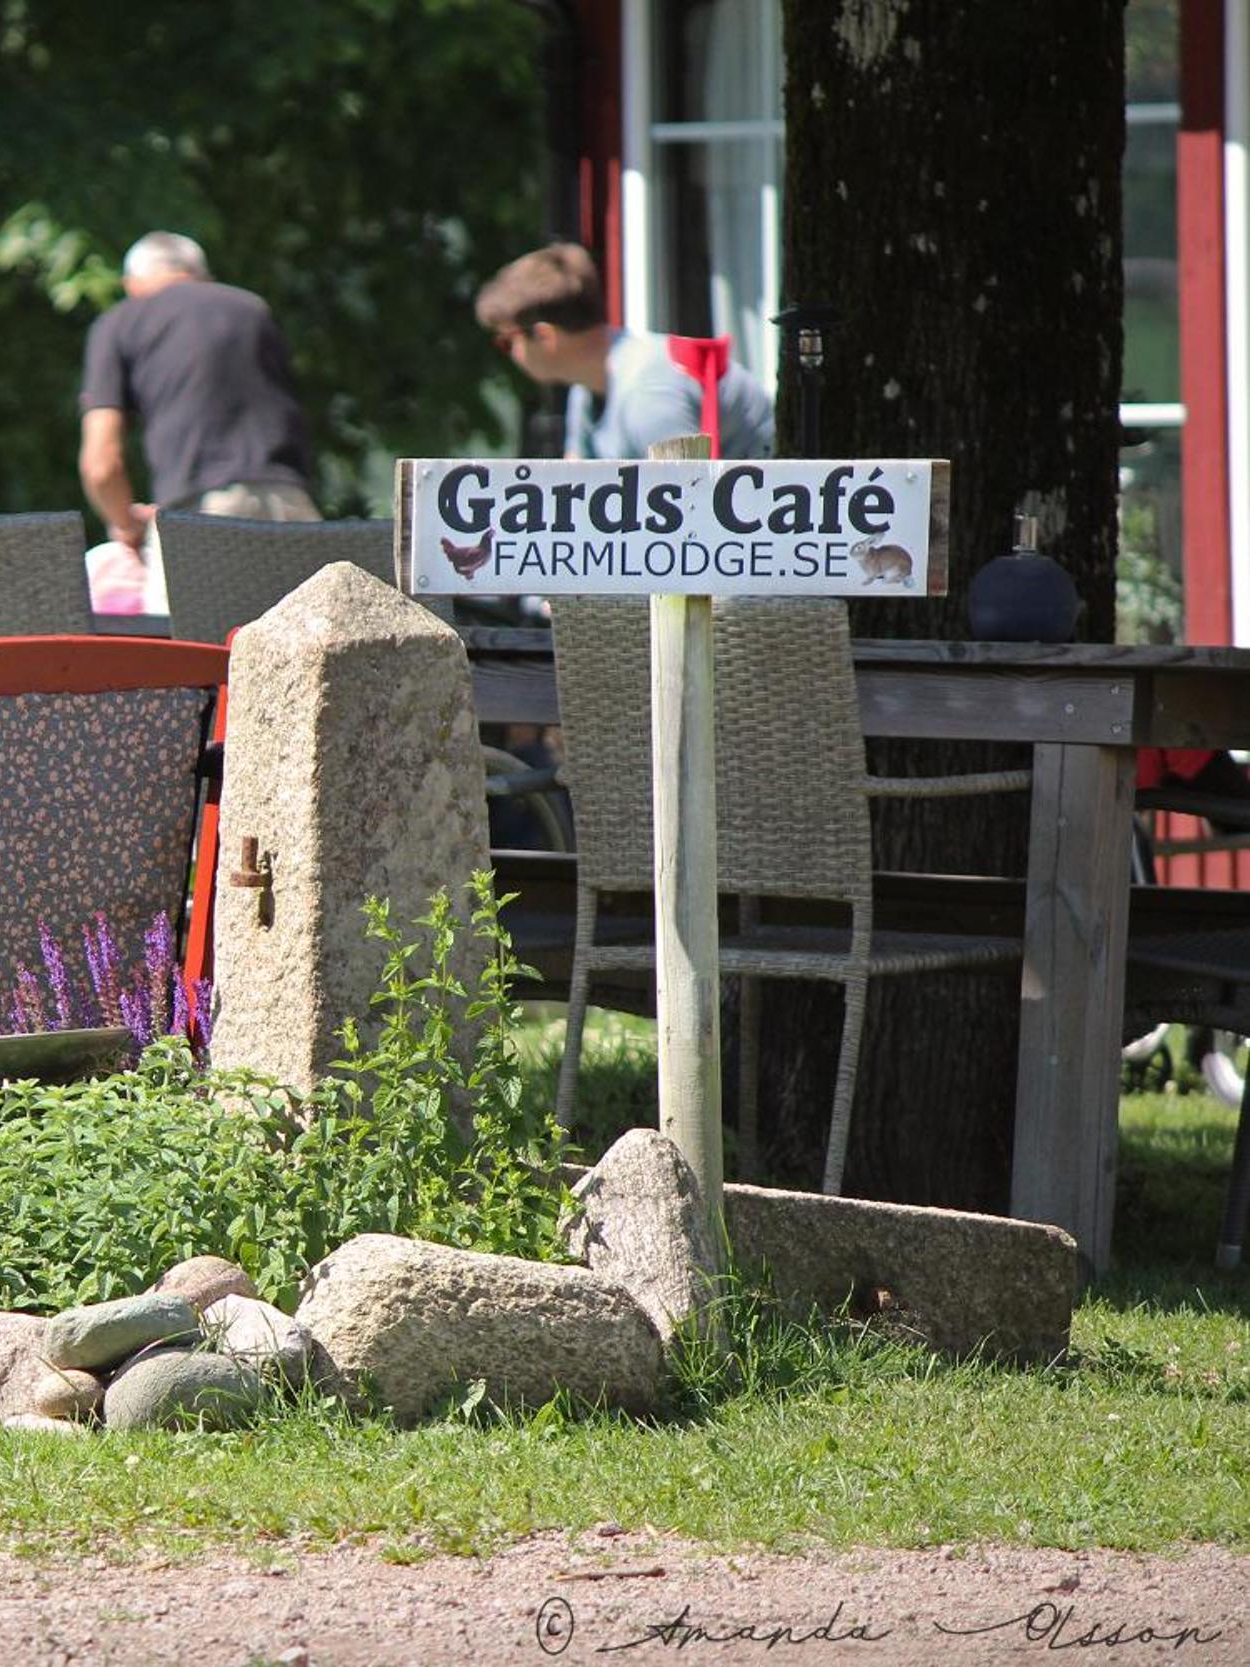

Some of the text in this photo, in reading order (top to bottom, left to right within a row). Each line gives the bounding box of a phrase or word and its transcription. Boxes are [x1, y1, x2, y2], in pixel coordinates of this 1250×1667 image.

[438, 464, 895, 534] Gårds Café
[493, 540, 849, 578] FARMLODGE.SE
